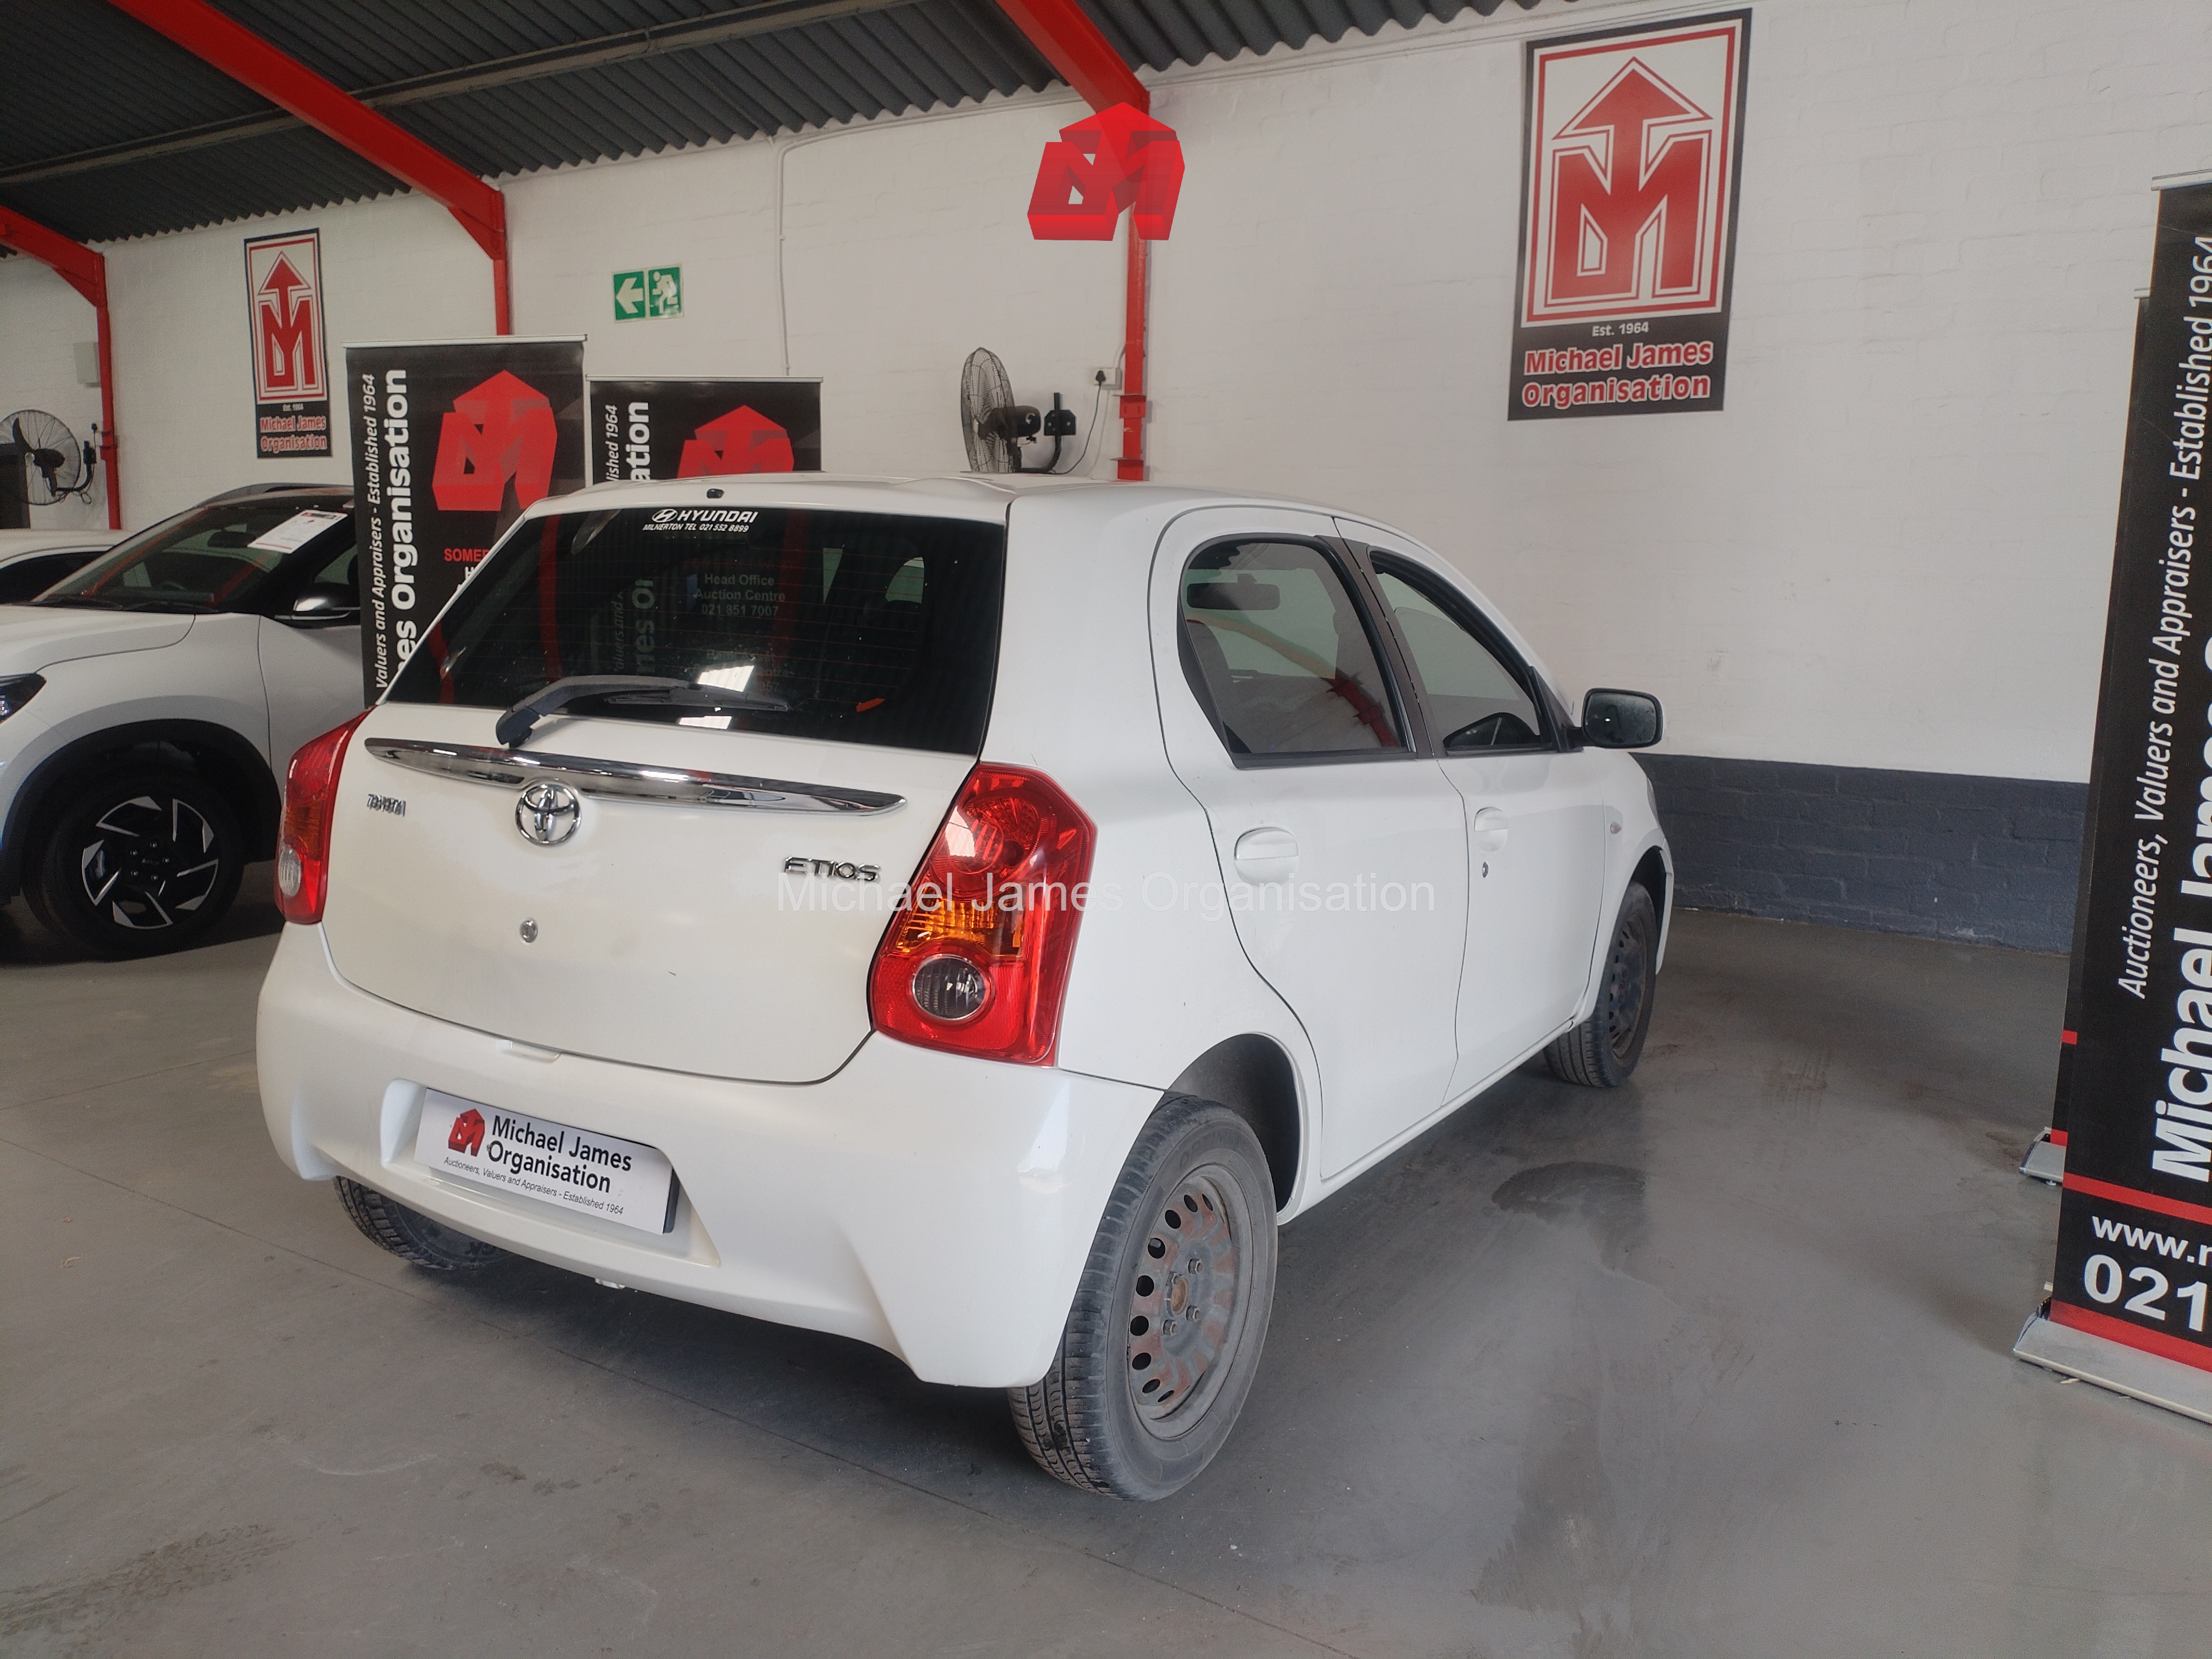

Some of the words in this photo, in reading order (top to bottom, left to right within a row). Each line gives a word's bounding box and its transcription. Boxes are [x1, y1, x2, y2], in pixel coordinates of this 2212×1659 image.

[1591, 325, 1615, 336] Est.
[1619, 322, 1649, 334] 1964
[1523, 343, 1623, 376] Michael
[1626, 340, 1714, 369] James
[362, 373, 376, 412] 1964
[1522, 373, 1711, 409] Organisation
[2169, 316, 2212, 480] Established
[260, 415, 296, 433] Michael
[296, 415, 326, 431] James
[605, 404, 618, 438] 1964
[260, 433, 327, 454] Organisation
[363, 415, 380, 504] Established
[384, 370, 418, 610] organisation
[642, 523, 684, 531] MILNERTON
[728, 524, 750, 532] 8899
[677, 510, 759, 523] HYUNDAI
[369, 517, 386, 598] Appraisers
[695, 589, 741, 600] Auction
[746, 589, 786, 602] Centre
[704, 573, 736, 585] Head
[739, 574, 775, 586] Office
[2152, 505, 2196, 655] Appraisers
[372, 599, 386, 630] and
[702, 604, 721, 615] 021
[375, 633, 388, 688] Valuers
[2149, 658, 2179, 714] and
[2135, 721, 2173, 821] Valuers
[783, 855, 882, 882] ETIOS
[2118, 834, 2168, 999] Auctioneers,
[492, 1115, 564, 1154] Michael
[569, 1136, 632, 1172] James
[444, 1157, 480, 1176] Auctioneers,
[483, 1168, 507, 1182] Valuers
[508, 1177, 520, 1186] and
[521, 1179, 557, 1196] Appraisers
[563, 1191, 604, 1210] Established
[606, 1203, 623, 1215] 1964
[488, 1140, 610, 1193] Organisation
[2084, 1254, 2208, 1332] 021
